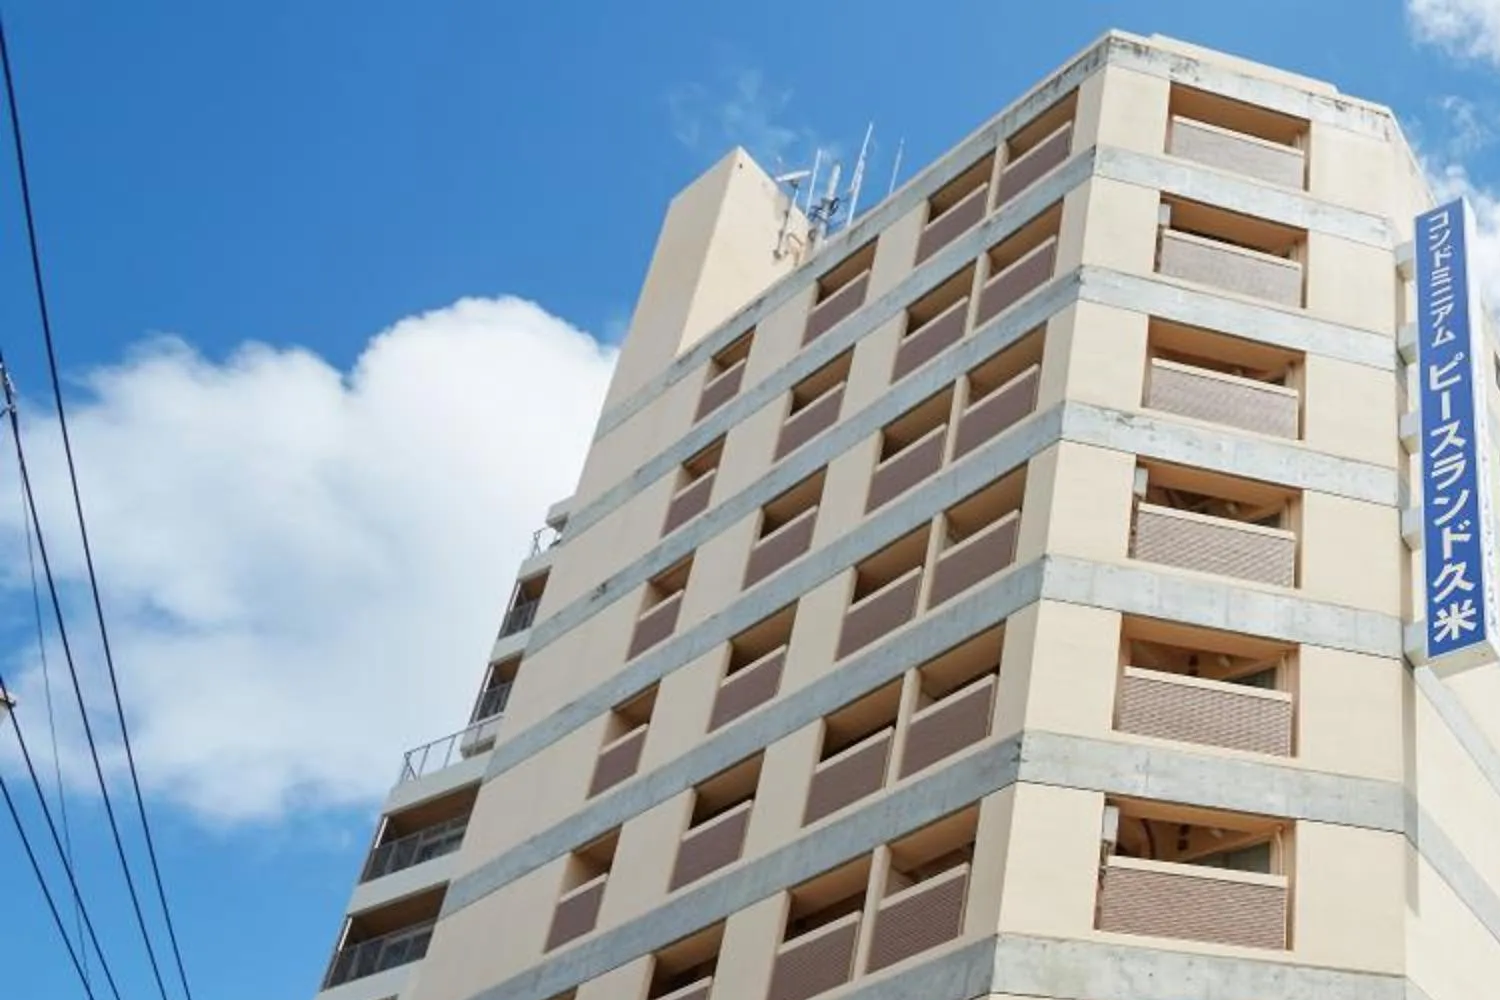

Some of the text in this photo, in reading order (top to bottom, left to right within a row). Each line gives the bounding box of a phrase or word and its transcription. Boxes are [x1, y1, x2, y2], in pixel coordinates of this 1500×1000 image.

[1427, 212, 1478, 642] コンドミニアム ピースランド久米
